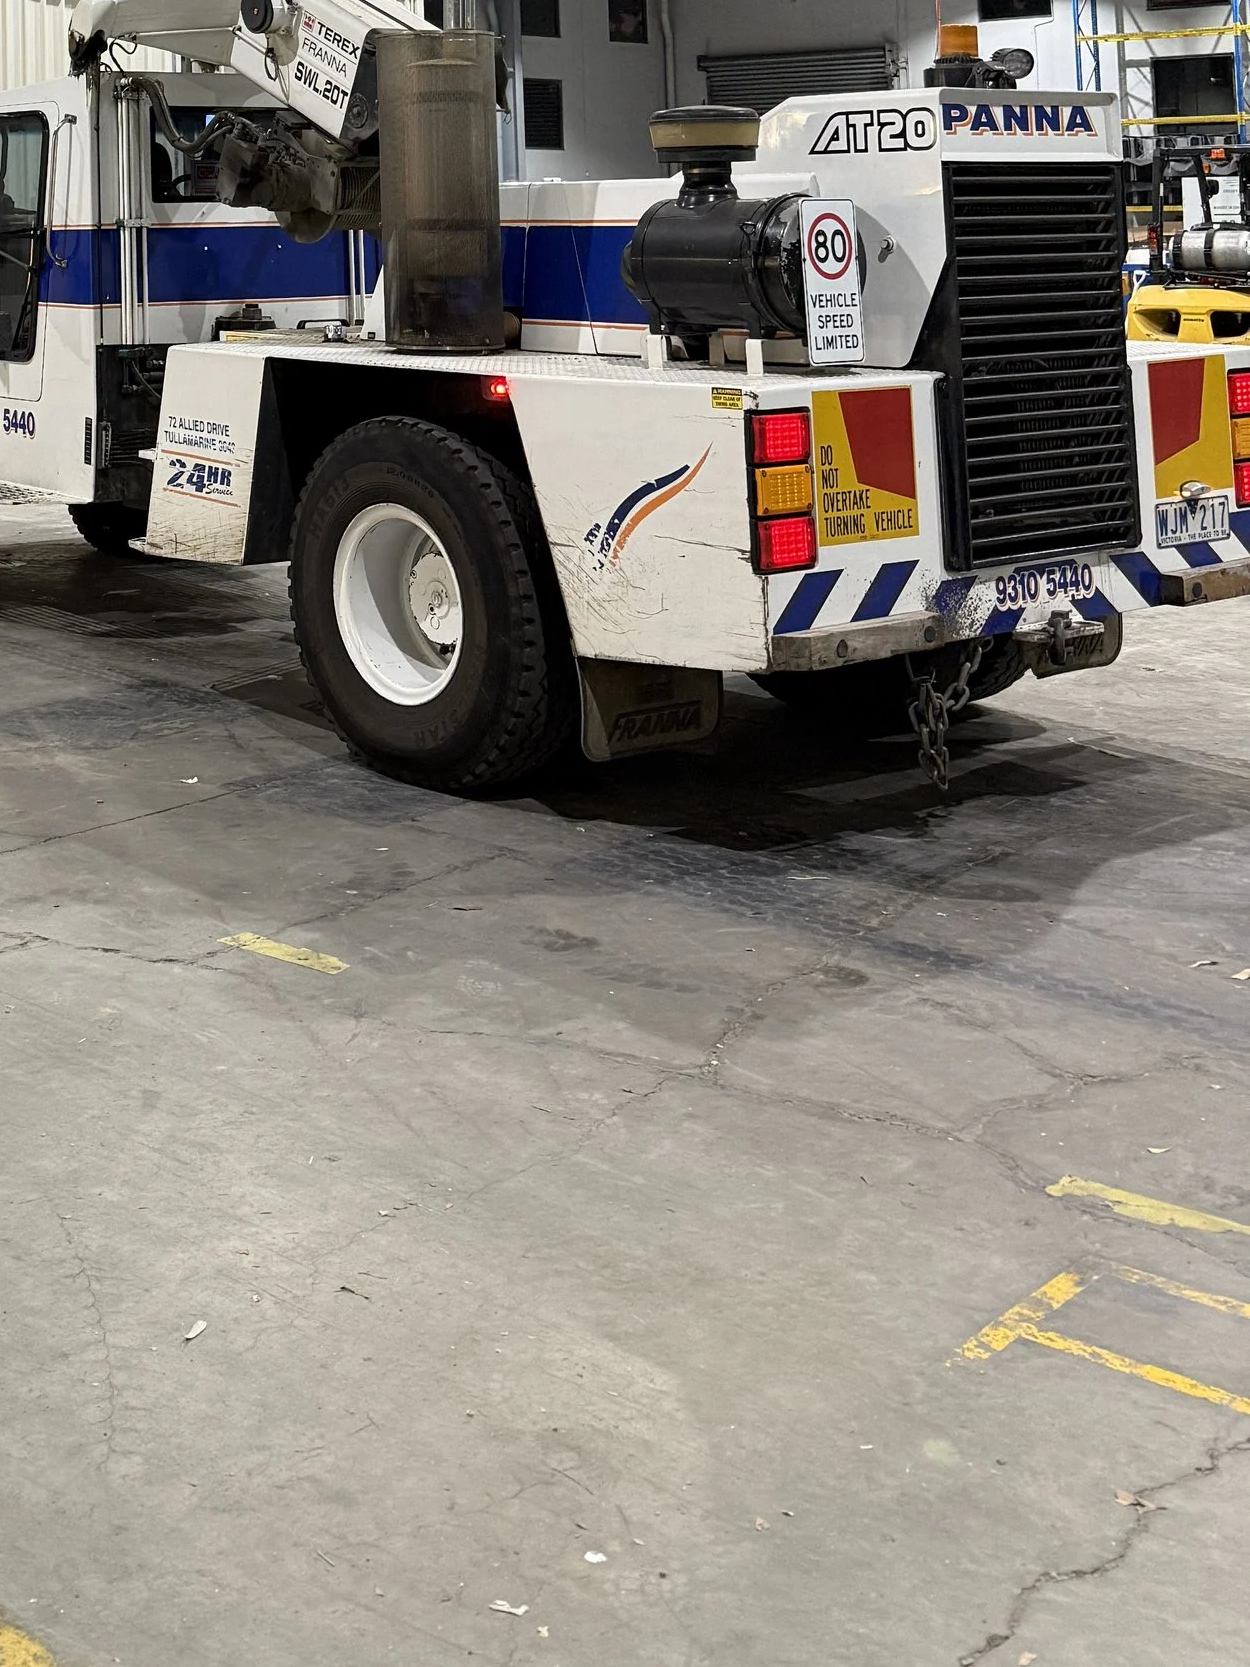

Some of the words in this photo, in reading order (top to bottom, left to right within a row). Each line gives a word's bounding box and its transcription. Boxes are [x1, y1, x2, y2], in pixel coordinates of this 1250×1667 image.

[317, 21, 360, 60] TEREX
[302, 37, 347, 78] FRANNA
[942, 104, 1098, 137] PANNA
[814, 229, 847, 264] 80
[810, 293, 858, 308] VEHICLE
[818, 314, 854, 329] SPEED
[815, 335, 859, 350] LIMITED
[3, 408, 36, 439] 5440
[168, 416, 177, 428] 72
[179, 417, 205, 433] ALLIED
[207, 421, 230, 437] DRIVE
[820, 444, 833, 466] DO
[822, 468, 839, 489] NOT
[823, 489, 871, 513] OVERTAKE
[824, 513, 866, 538] TURNING
[874, 509, 914, 532] VEHICLE
[1157, 507, 1189, 537] WJM
[1199, 501, 1226, 531] 217
[1161, 536, 1182, 545] VICTORIA
[1188, 533, 1196, 541] THE
[1198, 531, 1212, 540] PLACE
[995, 570, 1040, 609] 9310
[1046, 563, 1095, 599] 5440
